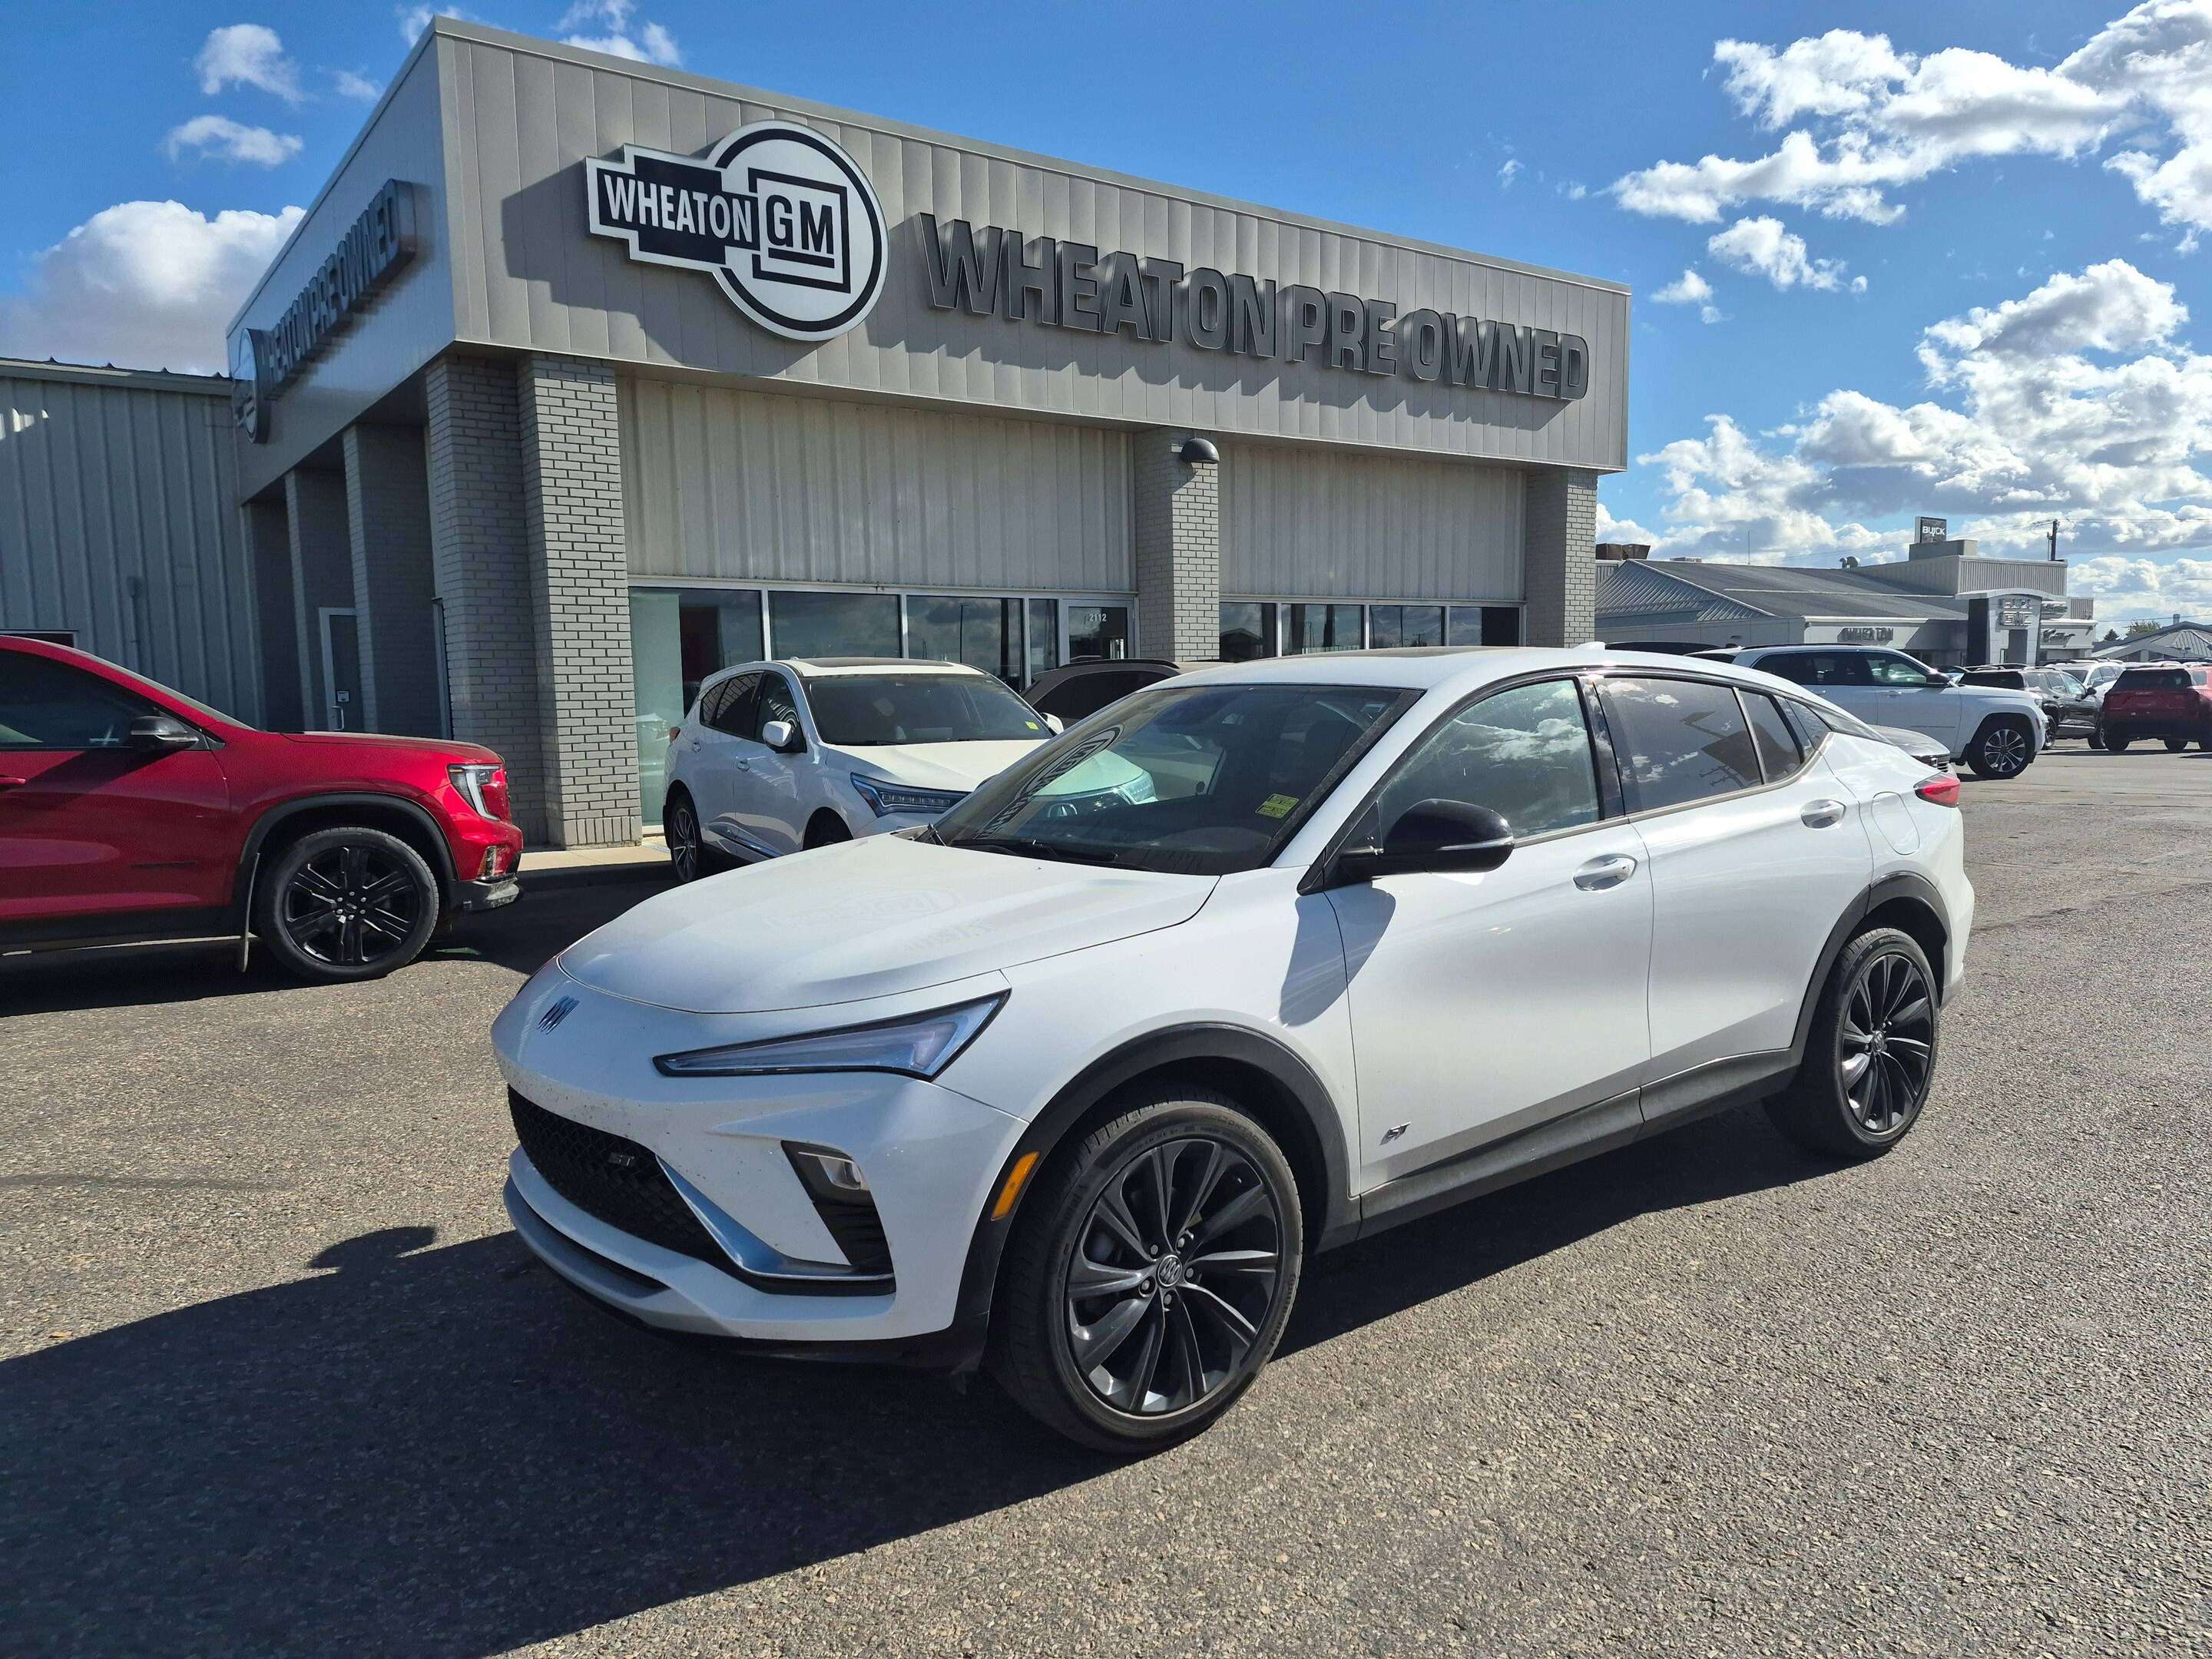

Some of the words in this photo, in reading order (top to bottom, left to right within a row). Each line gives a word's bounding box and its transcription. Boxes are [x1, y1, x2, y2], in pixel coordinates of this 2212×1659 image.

[604, 174, 752, 243] WHEATON
[767, 195, 834, 254] GM
[919, 212, 1277, 357] WHEATON
[1286, 284, 1397, 376] PRE
[1407, 309, 1589, 400] OWNED
[1922, 526, 1945, 535] BUICK
[1088, 614, 1107, 622] 2112
